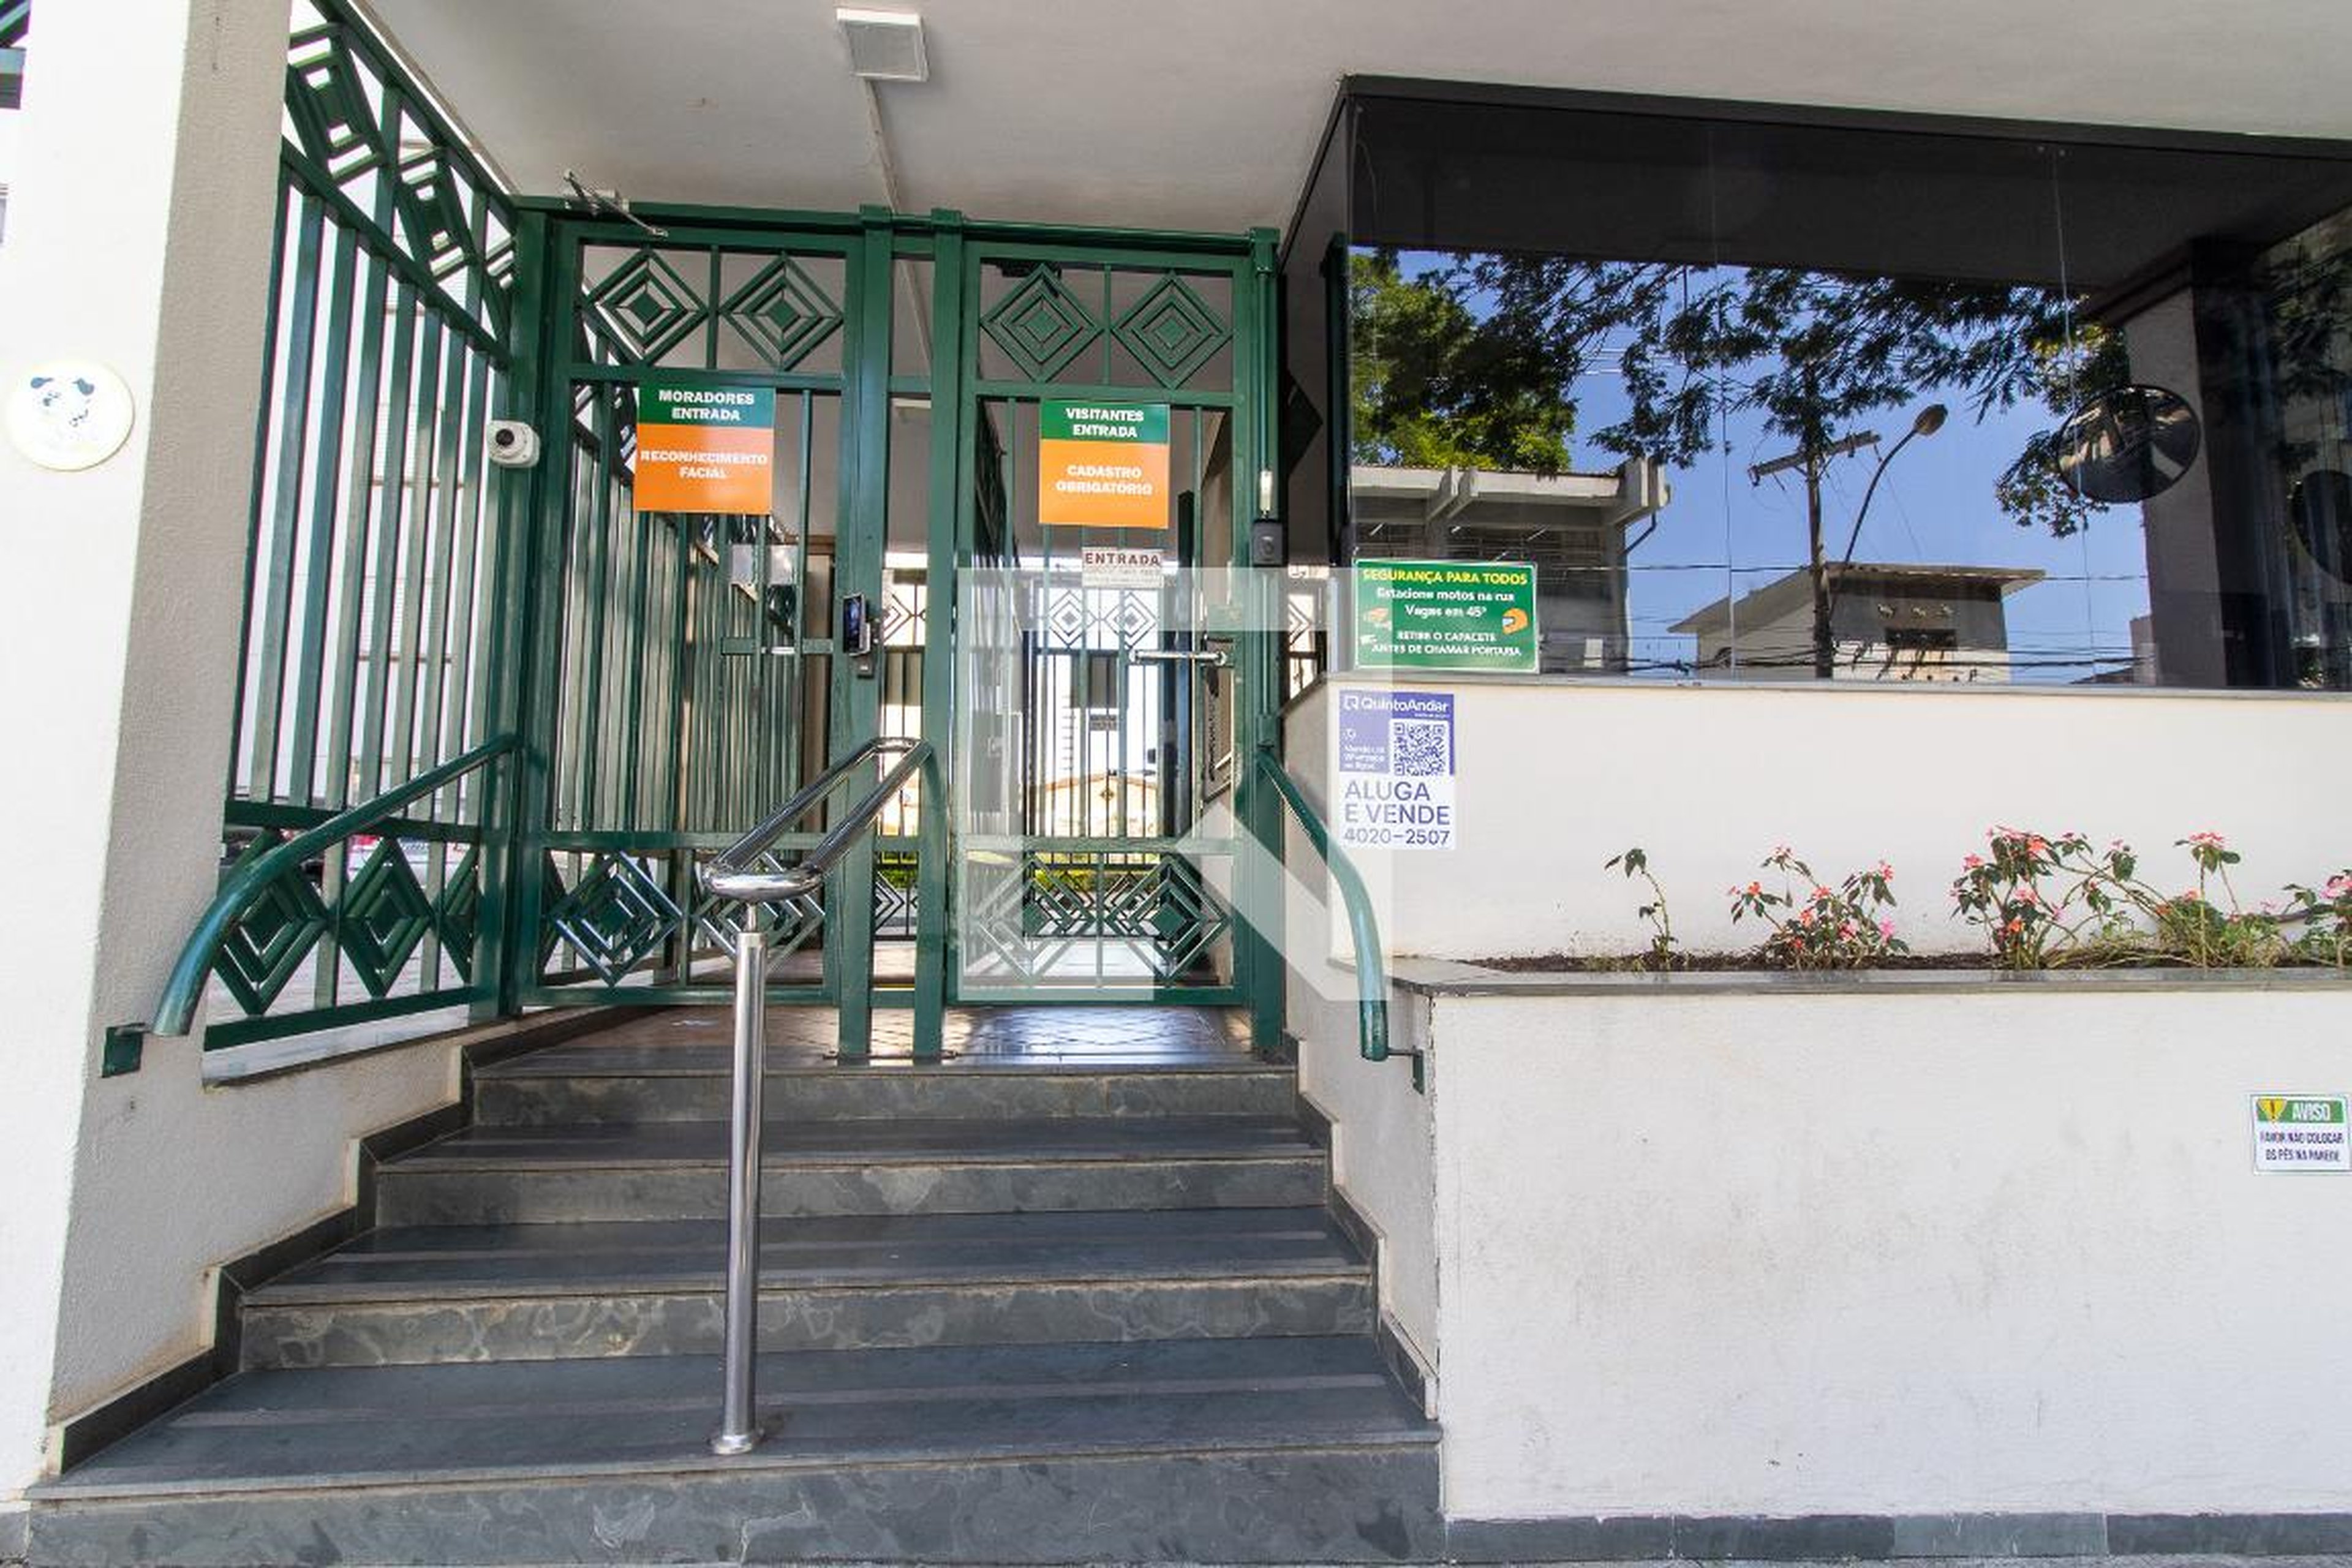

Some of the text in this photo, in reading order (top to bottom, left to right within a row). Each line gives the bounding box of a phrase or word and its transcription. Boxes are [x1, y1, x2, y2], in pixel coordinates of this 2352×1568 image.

[658, 390, 755, 405] MORADORES
[671, 407, 741, 421] ENTRADA
[1066, 408, 1144, 421] VISITANTES
[1073, 424, 1137, 438] ENTRADA
[640, 450, 767, 466] RECONHECIMENTO
[679, 467, 728, 479] FACIAL
[1067, 465, 1142, 479] CADASTRO
[1085, 552, 1161, 567] ENTRADA
[1363, 568, 1528, 586] SEGURANÇA PARA TODOS
[1376, 587, 1515, 603] Estacione motos na rua
[1404, 604, 1442, 619] Vagas
[1444, 608, 1464, 617] em
[1433, 631, 1442, 641] O
[1445, 631, 1497, 642] CAPACETE
[1372, 644, 1406, 654] ANTES
[1408, 645, 1423, 655] DE
[1424, 645, 1469, 655] CHAMAR
[1362, 697, 1449, 713] QuintoAndar
[1344, 780, 1431, 801] ALUGA
[1345, 804, 1450, 826] E VENDE
[2293, 1102, 2331, 1121] AVISO
